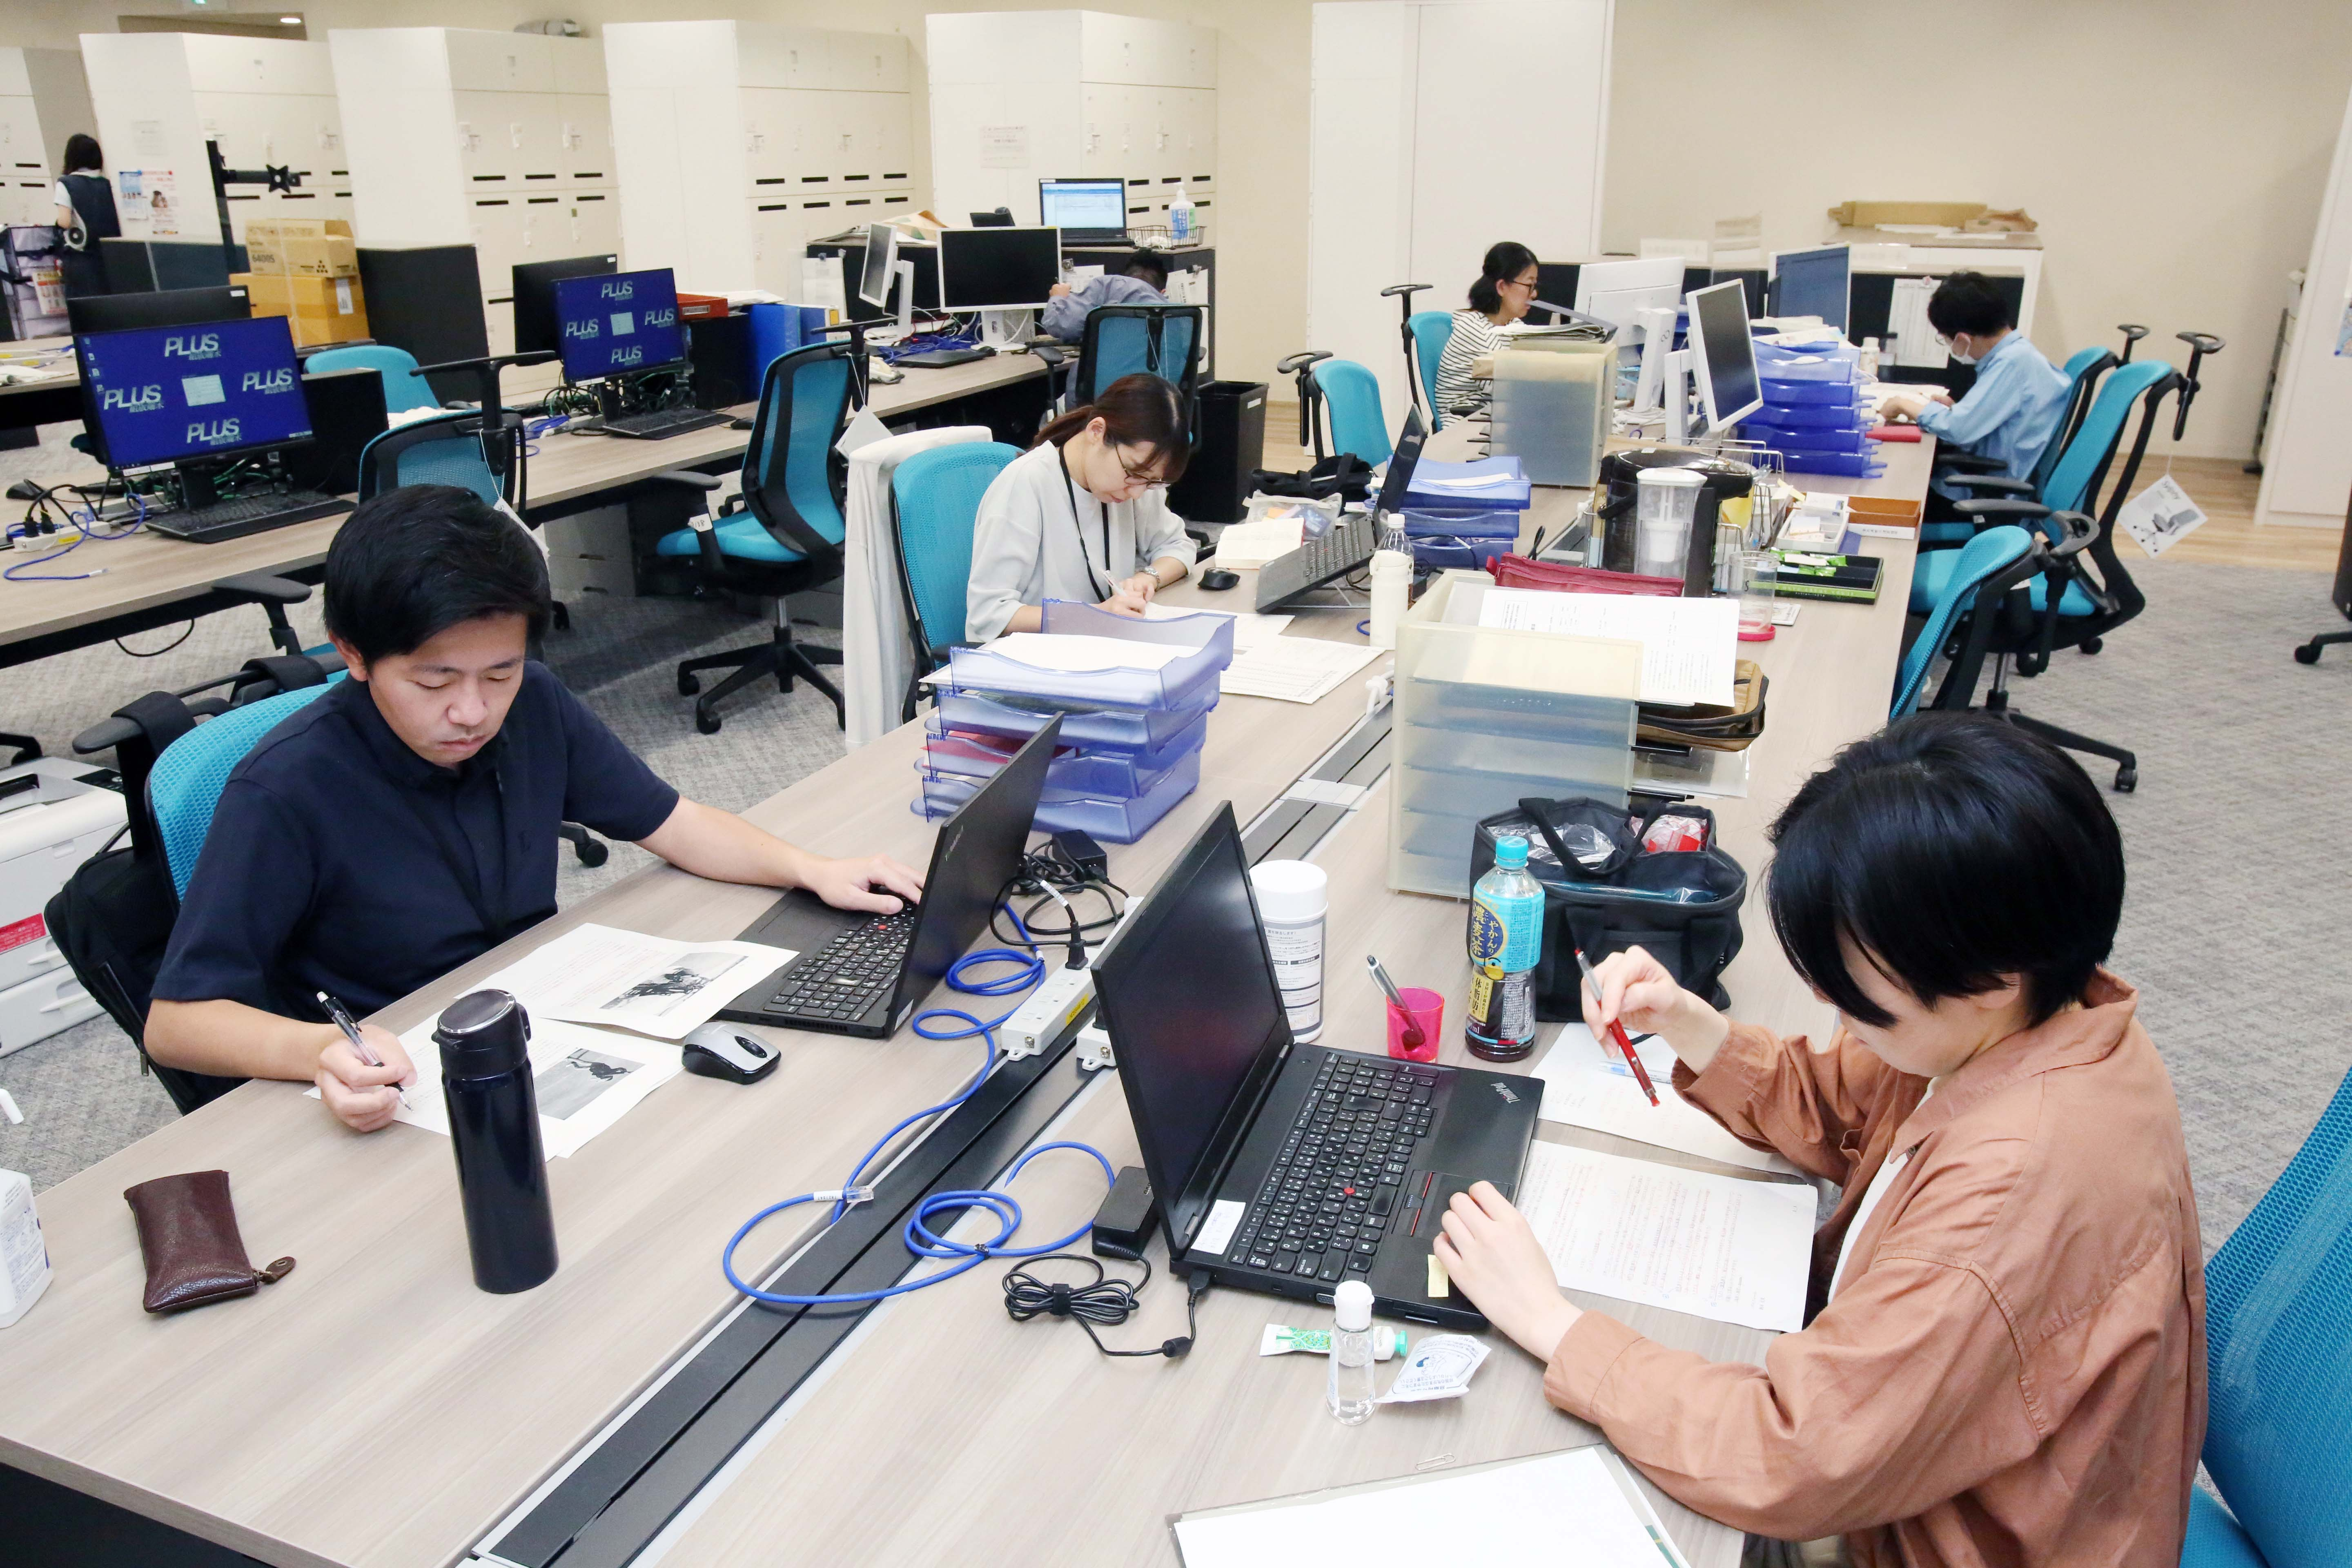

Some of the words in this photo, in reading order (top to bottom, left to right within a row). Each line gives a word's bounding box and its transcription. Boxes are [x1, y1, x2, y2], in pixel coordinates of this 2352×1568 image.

[601, 281, 633, 298] PLUS
[566, 318, 599, 337] PLUS
[644, 308, 674, 325] PLUS
[165, 333, 219, 357] PLUS
[611, 345, 642, 363] PLUS
[242, 368, 292, 392] PLUS
[104, 385, 161, 410] PLUS
[187, 418, 240, 444] PLUS
[1487, 921, 1499, 953] やかんの
[1490, 1082, 1522, 1104] ThinkPad
